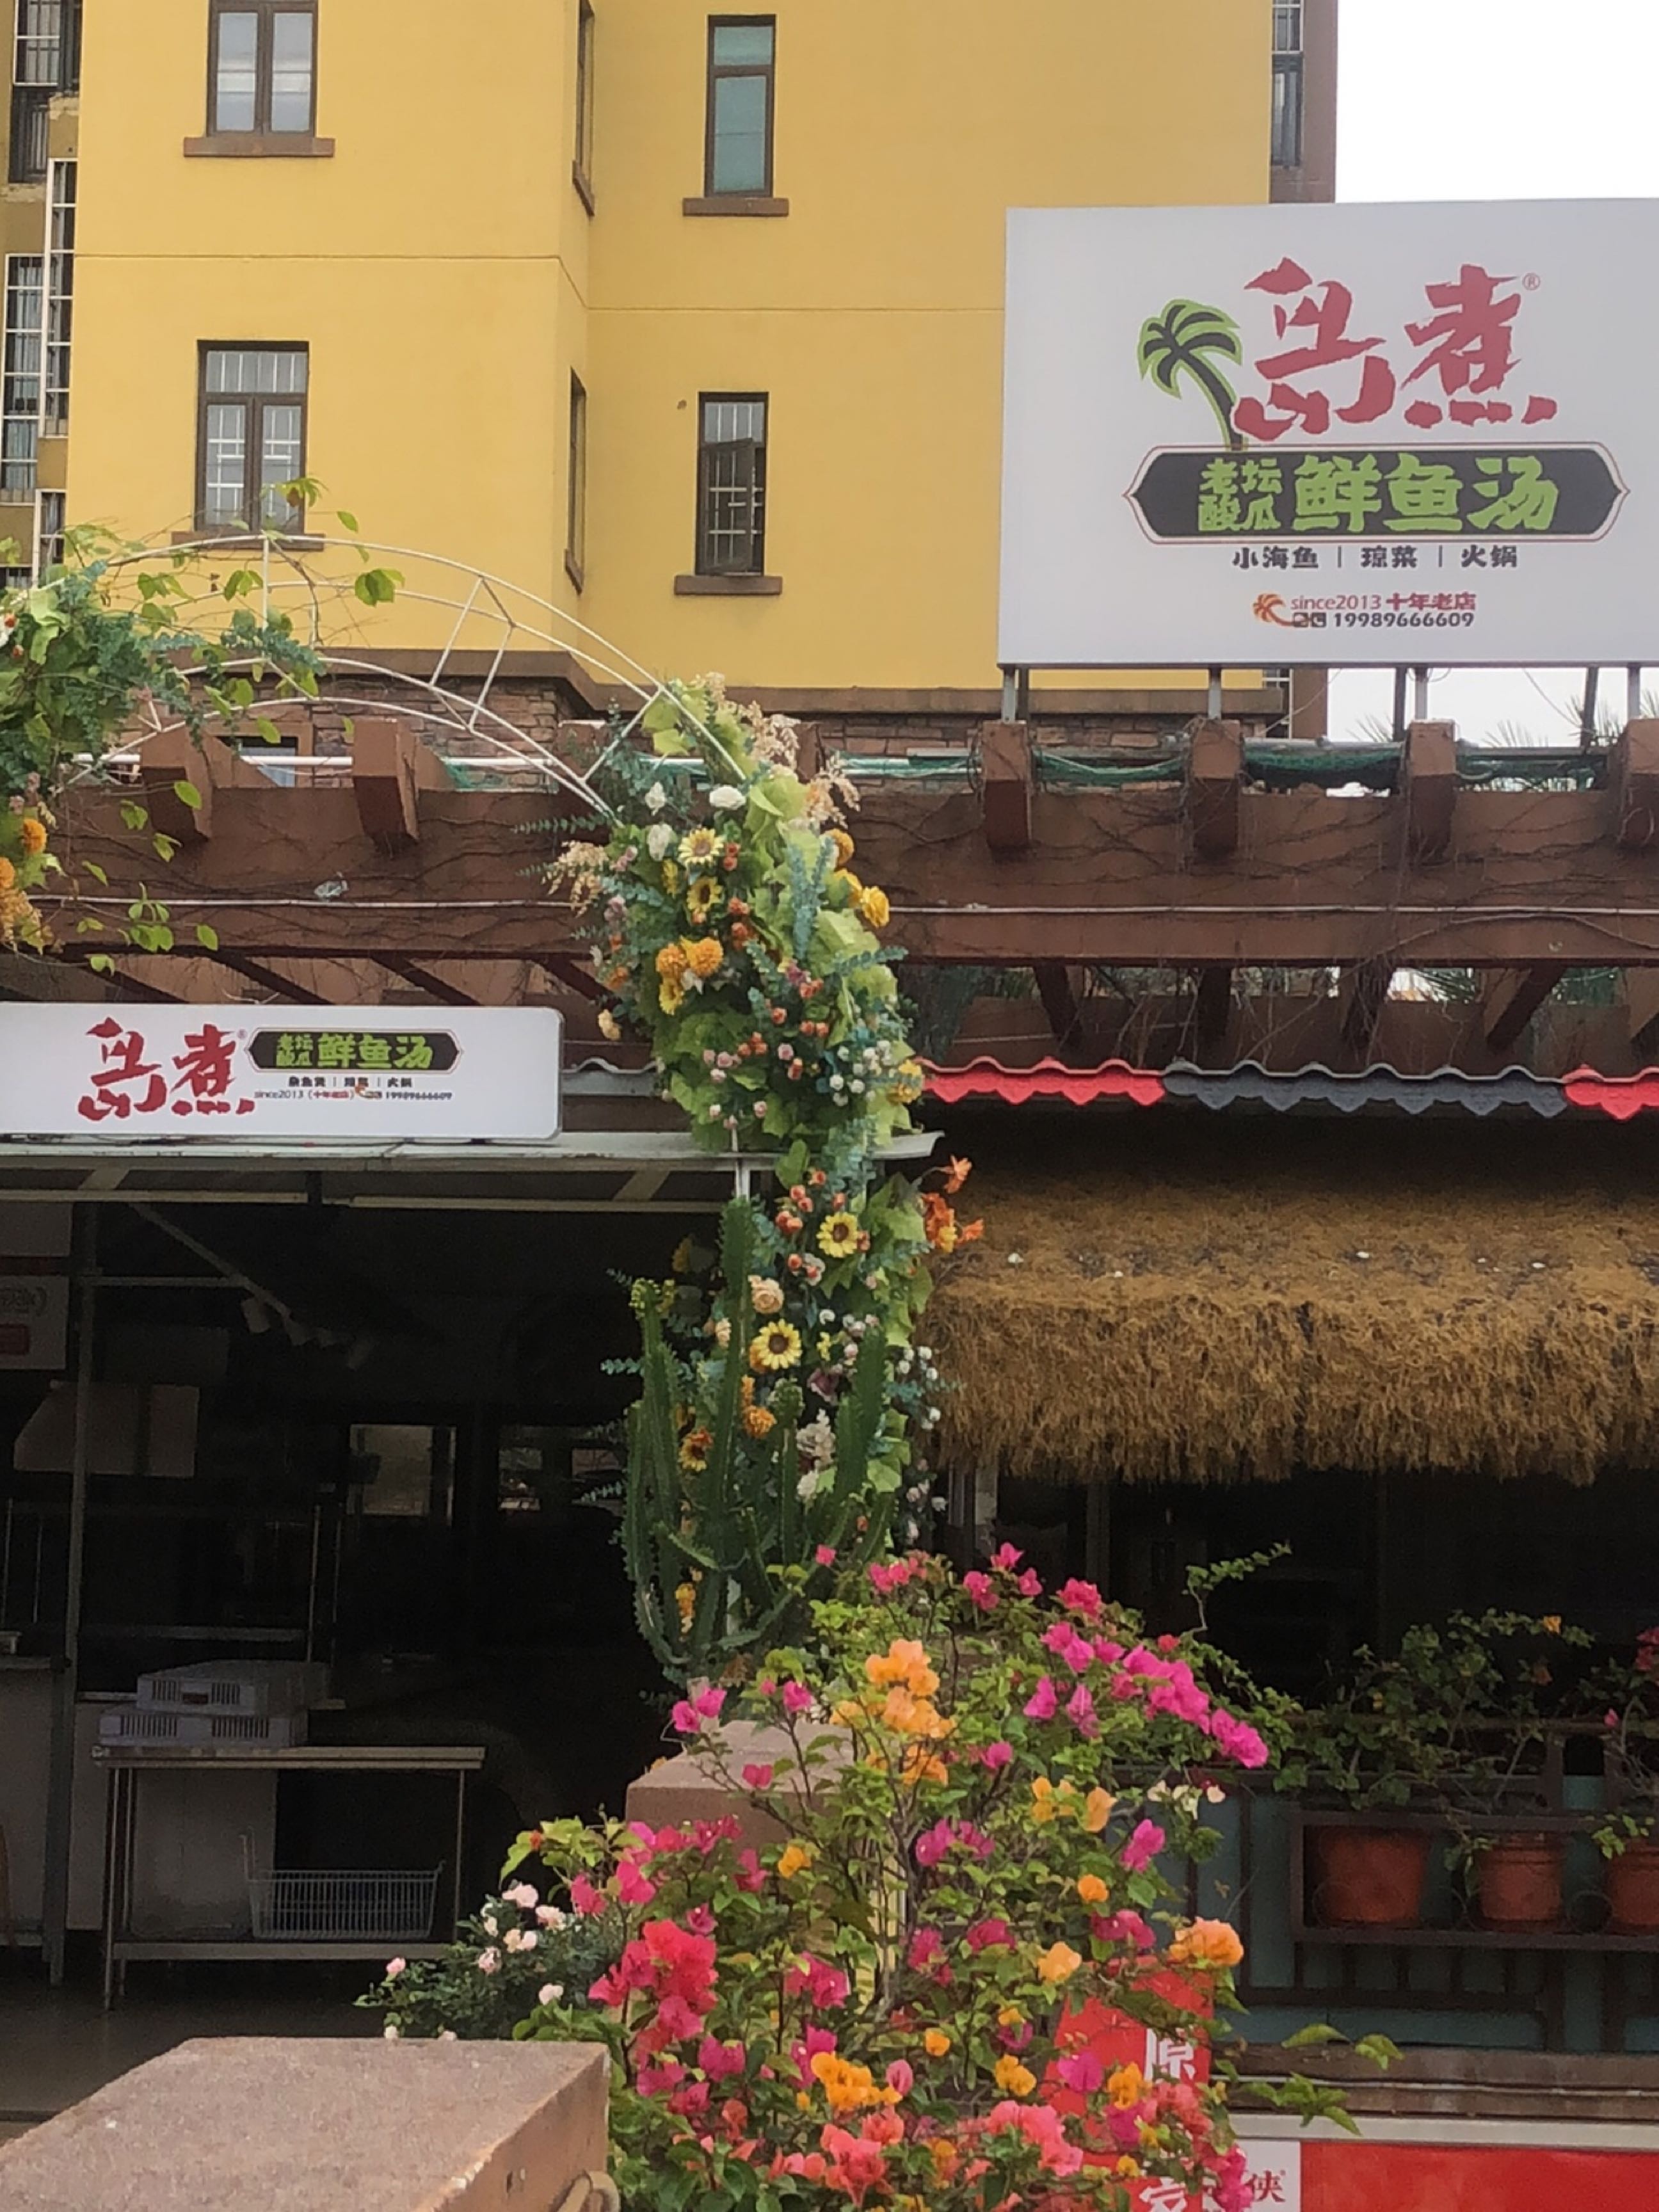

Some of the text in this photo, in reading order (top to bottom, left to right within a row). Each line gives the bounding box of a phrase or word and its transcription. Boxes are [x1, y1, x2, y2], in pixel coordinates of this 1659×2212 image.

[1201, 458, 1282, 494] 老坛
[1292, 452, 1558, 533] 鲜鱼汤
[1233, 545, 1519, 570] 小海鱼 琼菜 火锅
[1290, 593, 1477, 611] since2013 十年老店
[1334, 613, 1475, 628] 19989666609
[317, 1032, 433, 1070] 鲜鱼汤
